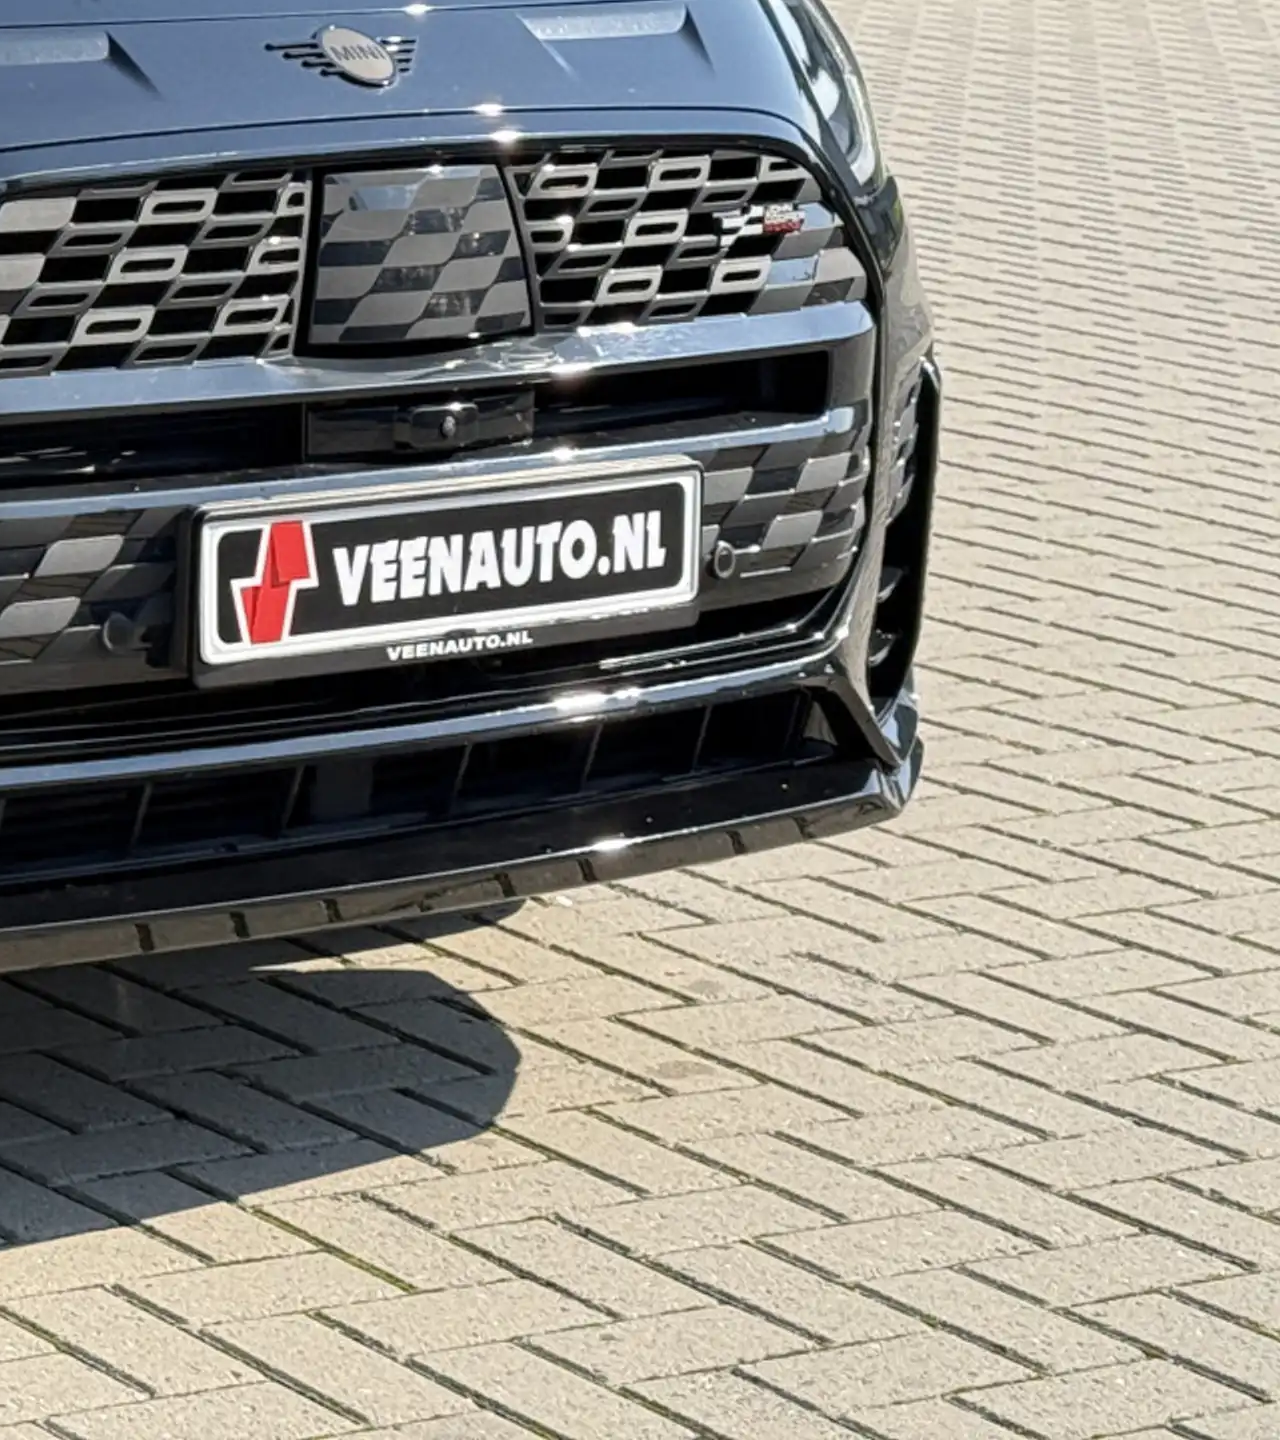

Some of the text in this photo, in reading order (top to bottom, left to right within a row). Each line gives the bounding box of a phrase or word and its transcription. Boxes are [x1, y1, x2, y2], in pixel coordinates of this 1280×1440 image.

[330, 44, 387, 60] MINI
[333, 510, 666, 606] VEENAUTO.NL
[386, 631, 533, 661] VEENAUTO.NL
